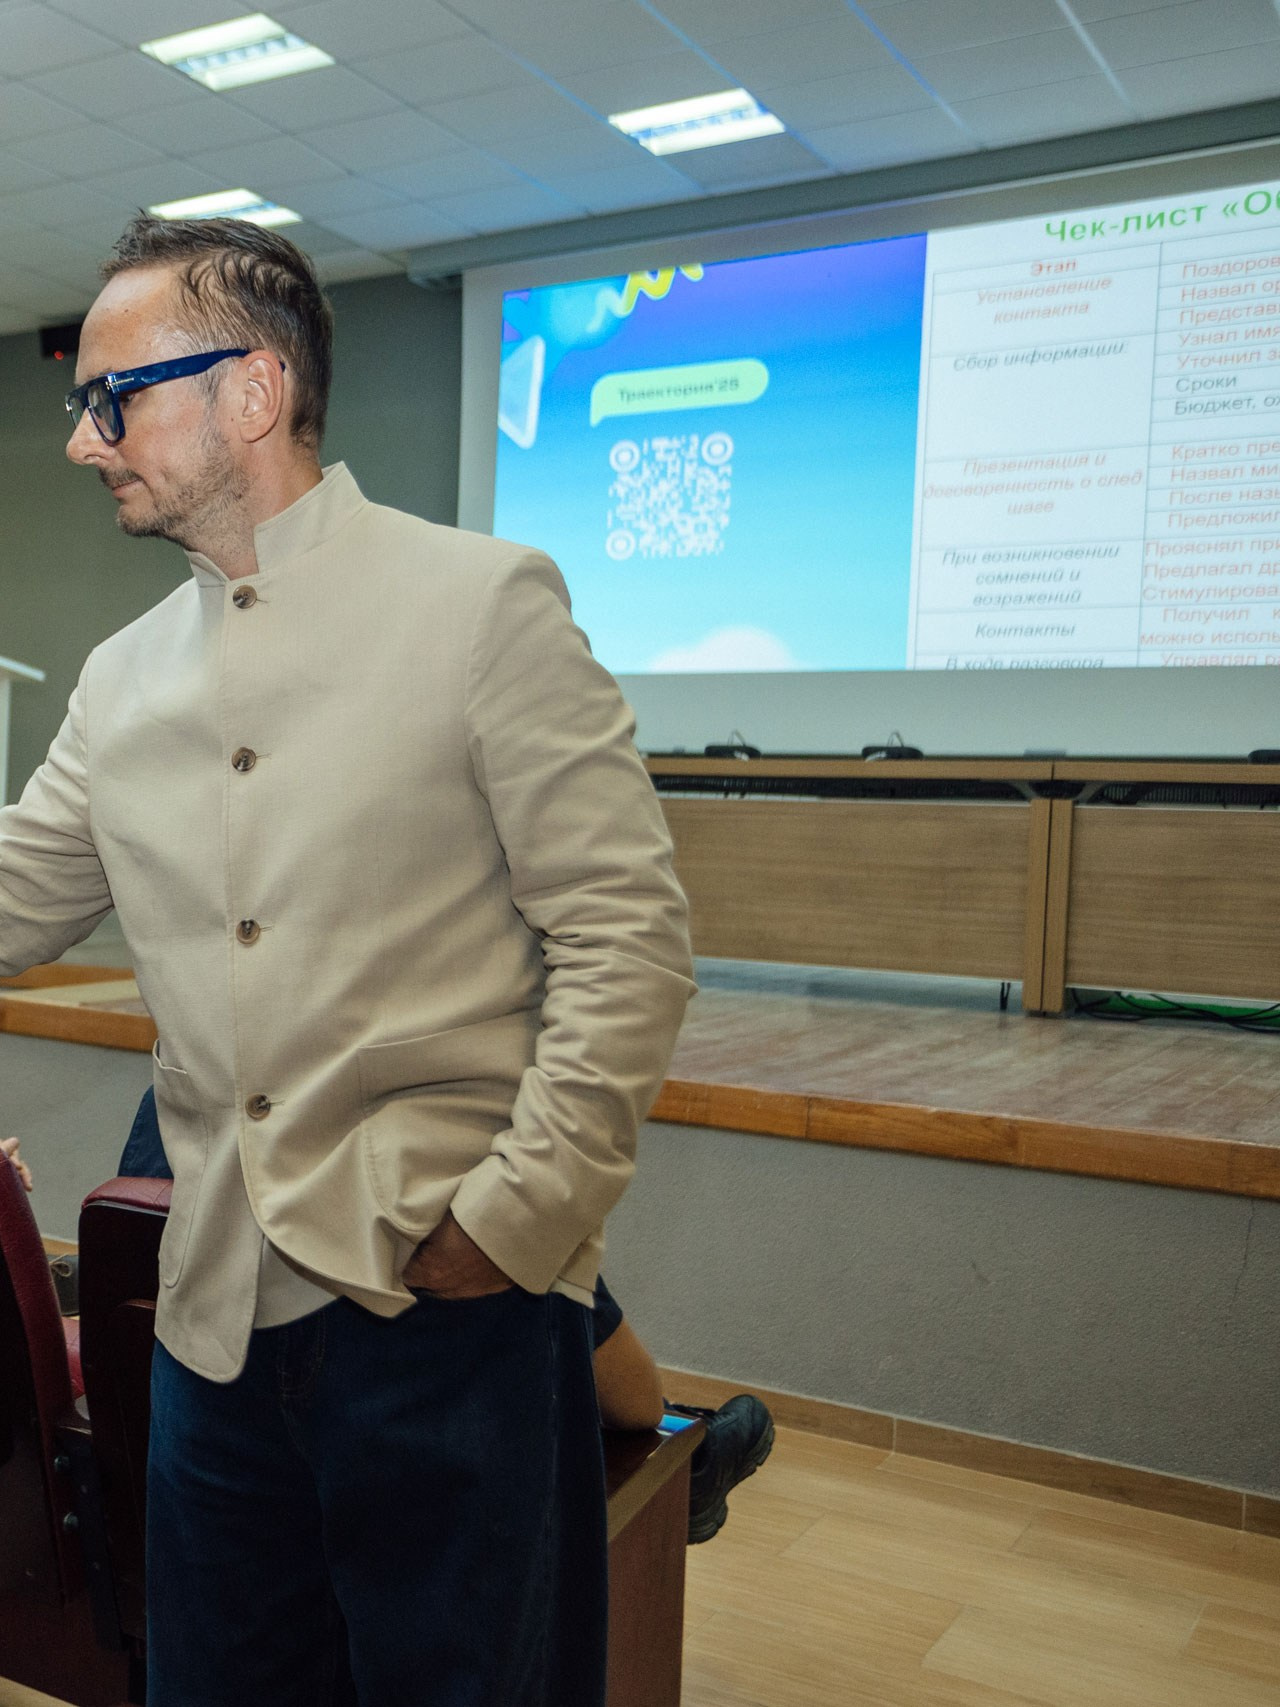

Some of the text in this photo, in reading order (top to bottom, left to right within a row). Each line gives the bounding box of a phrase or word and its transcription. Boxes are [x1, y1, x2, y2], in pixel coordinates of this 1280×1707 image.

[1045, 188, 1280, 242] Чек-лист «О
[1030, 259, 1077, 277] Этап
[977, 275, 1112, 305] Установление
[1180, 280, 1256, 302] Назвал
[993, 300, 1090, 325] контакта
[1178, 329, 1237, 348] Узнал
[954, 354, 998, 371] Сбор
[1177, 350, 1261, 370] Уточнил
[1175, 375, 1237, 394] Сроки
[1174, 396, 1256, 416] Бюджет,
[1171, 442, 1239, 461] Кратко
[963, 452, 1107, 476] Презентация и
[1170, 465, 1245, 482] Назвал
[923, 477, 1074, 500] договоренность
[1080, 478, 1092, 490] о
[1168, 488, 1232, 505] После
[1007, 500, 1054, 516] шаге
[943, 545, 1119, 567] При возникновении
[1145, 539, 1243, 558] Прояснял
[976, 568, 1080, 586] сомнений и
[1143, 562, 1252, 581] Предлагал
[972, 590, 1081, 608] возражений
[1143, 585, 1280, 604] Стимулирова
[1162, 606, 1249, 625] Получил
[975, 622, 1075, 639] Контакты
[1140, 631, 1204, 645] можно
